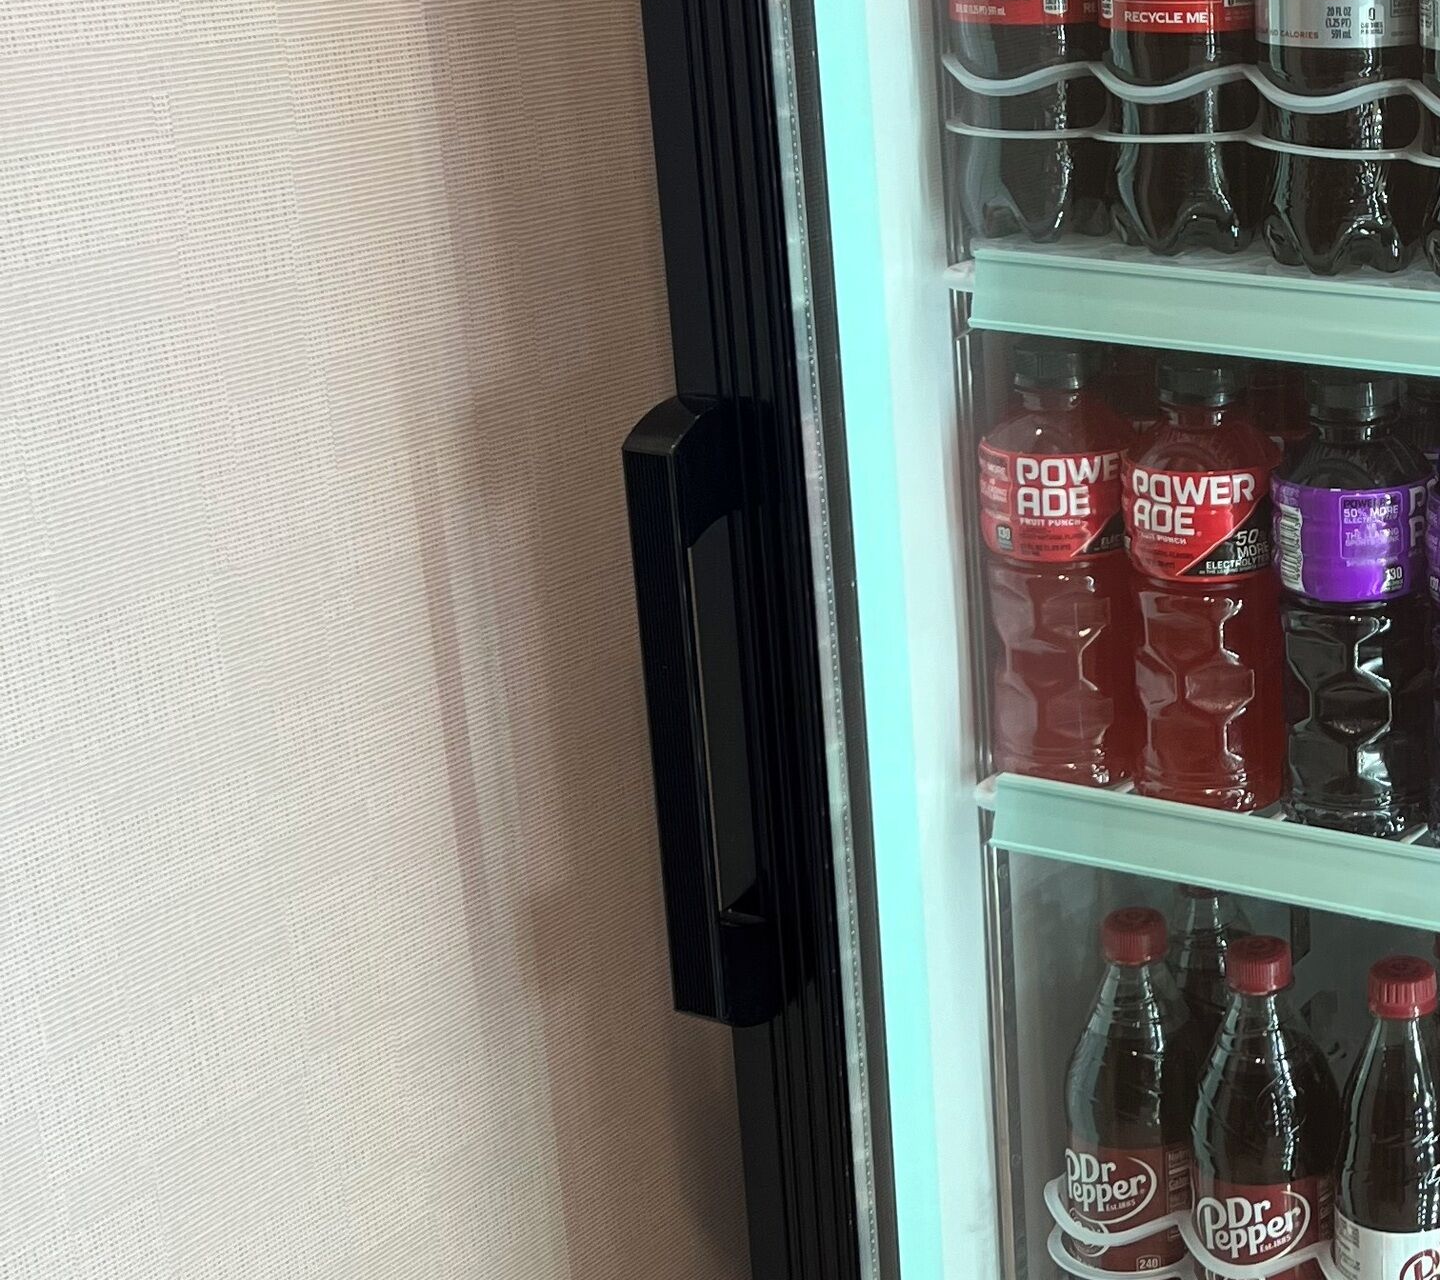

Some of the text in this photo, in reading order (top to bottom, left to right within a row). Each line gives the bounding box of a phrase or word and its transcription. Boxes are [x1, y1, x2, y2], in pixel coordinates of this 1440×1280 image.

[1124, 10, 1208, 24] RECYCLE ME
[1326, 7, 1352, 16] 20 FL OZ
[1280, 30, 1319, 39] CALORIES
[1331, 29, 1341, 39] 591
[1132, 469, 1255, 506] POWER
[1017, 485, 1091, 517] ADE
[1020, 519, 1082, 527] FRUIT PUNCH
[1133, 498, 1195, 536] ADE
[1236, 541, 1270, 559] MORE
[1065, 1148, 1147, 1212] Pepper
[1079, 1153, 1117, 1183] Dr
[1226, 1197, 1271, 1229] Dr
[1197, 1197, 1301, 1259] Pepper
[1140, 1259, 1158, 1269] 240
